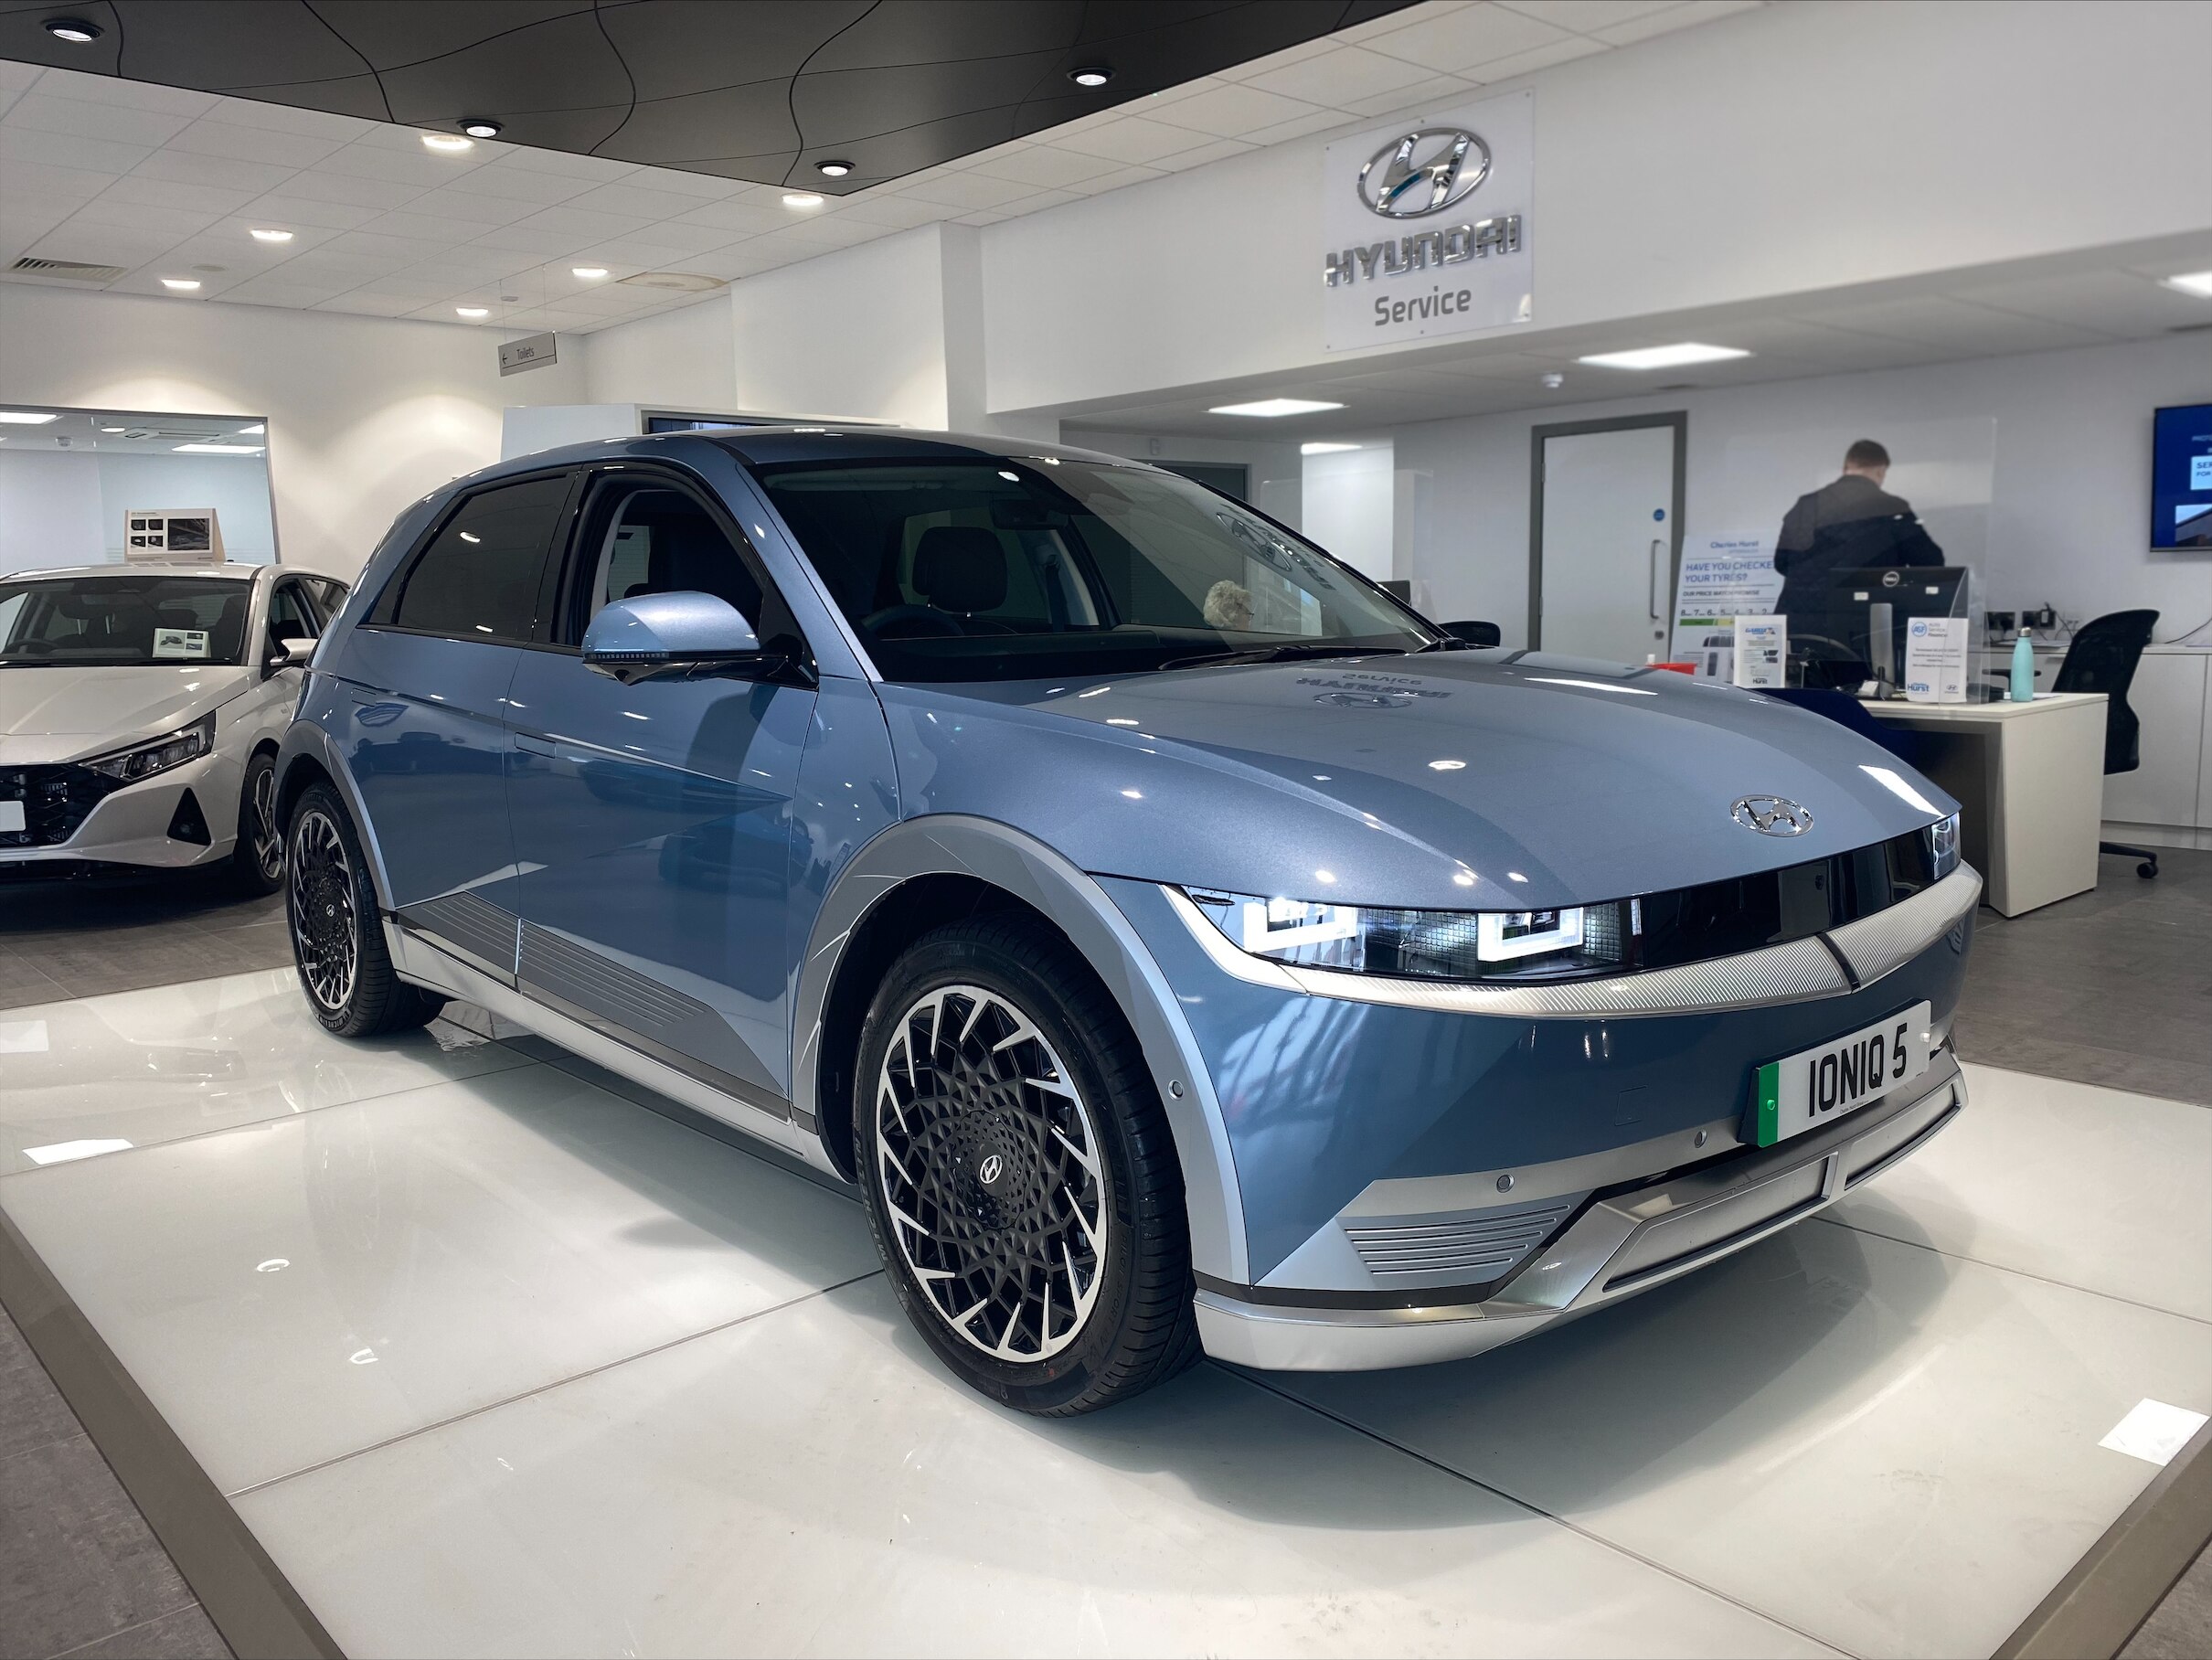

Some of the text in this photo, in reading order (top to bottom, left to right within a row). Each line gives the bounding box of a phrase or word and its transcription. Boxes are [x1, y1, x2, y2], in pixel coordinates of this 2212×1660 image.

[1324, 214, 1522, 288] HYUNDAI
[1374, 285, 1473, 326] Service
[516, 346, 535, 361] Toilets
[1685, 574, 1711, 583] YOUR
[1686, 560, 1773, 572] HAVE YOU CHECKE
[1808, 1022, 1908, 1118] IONIQ 5
